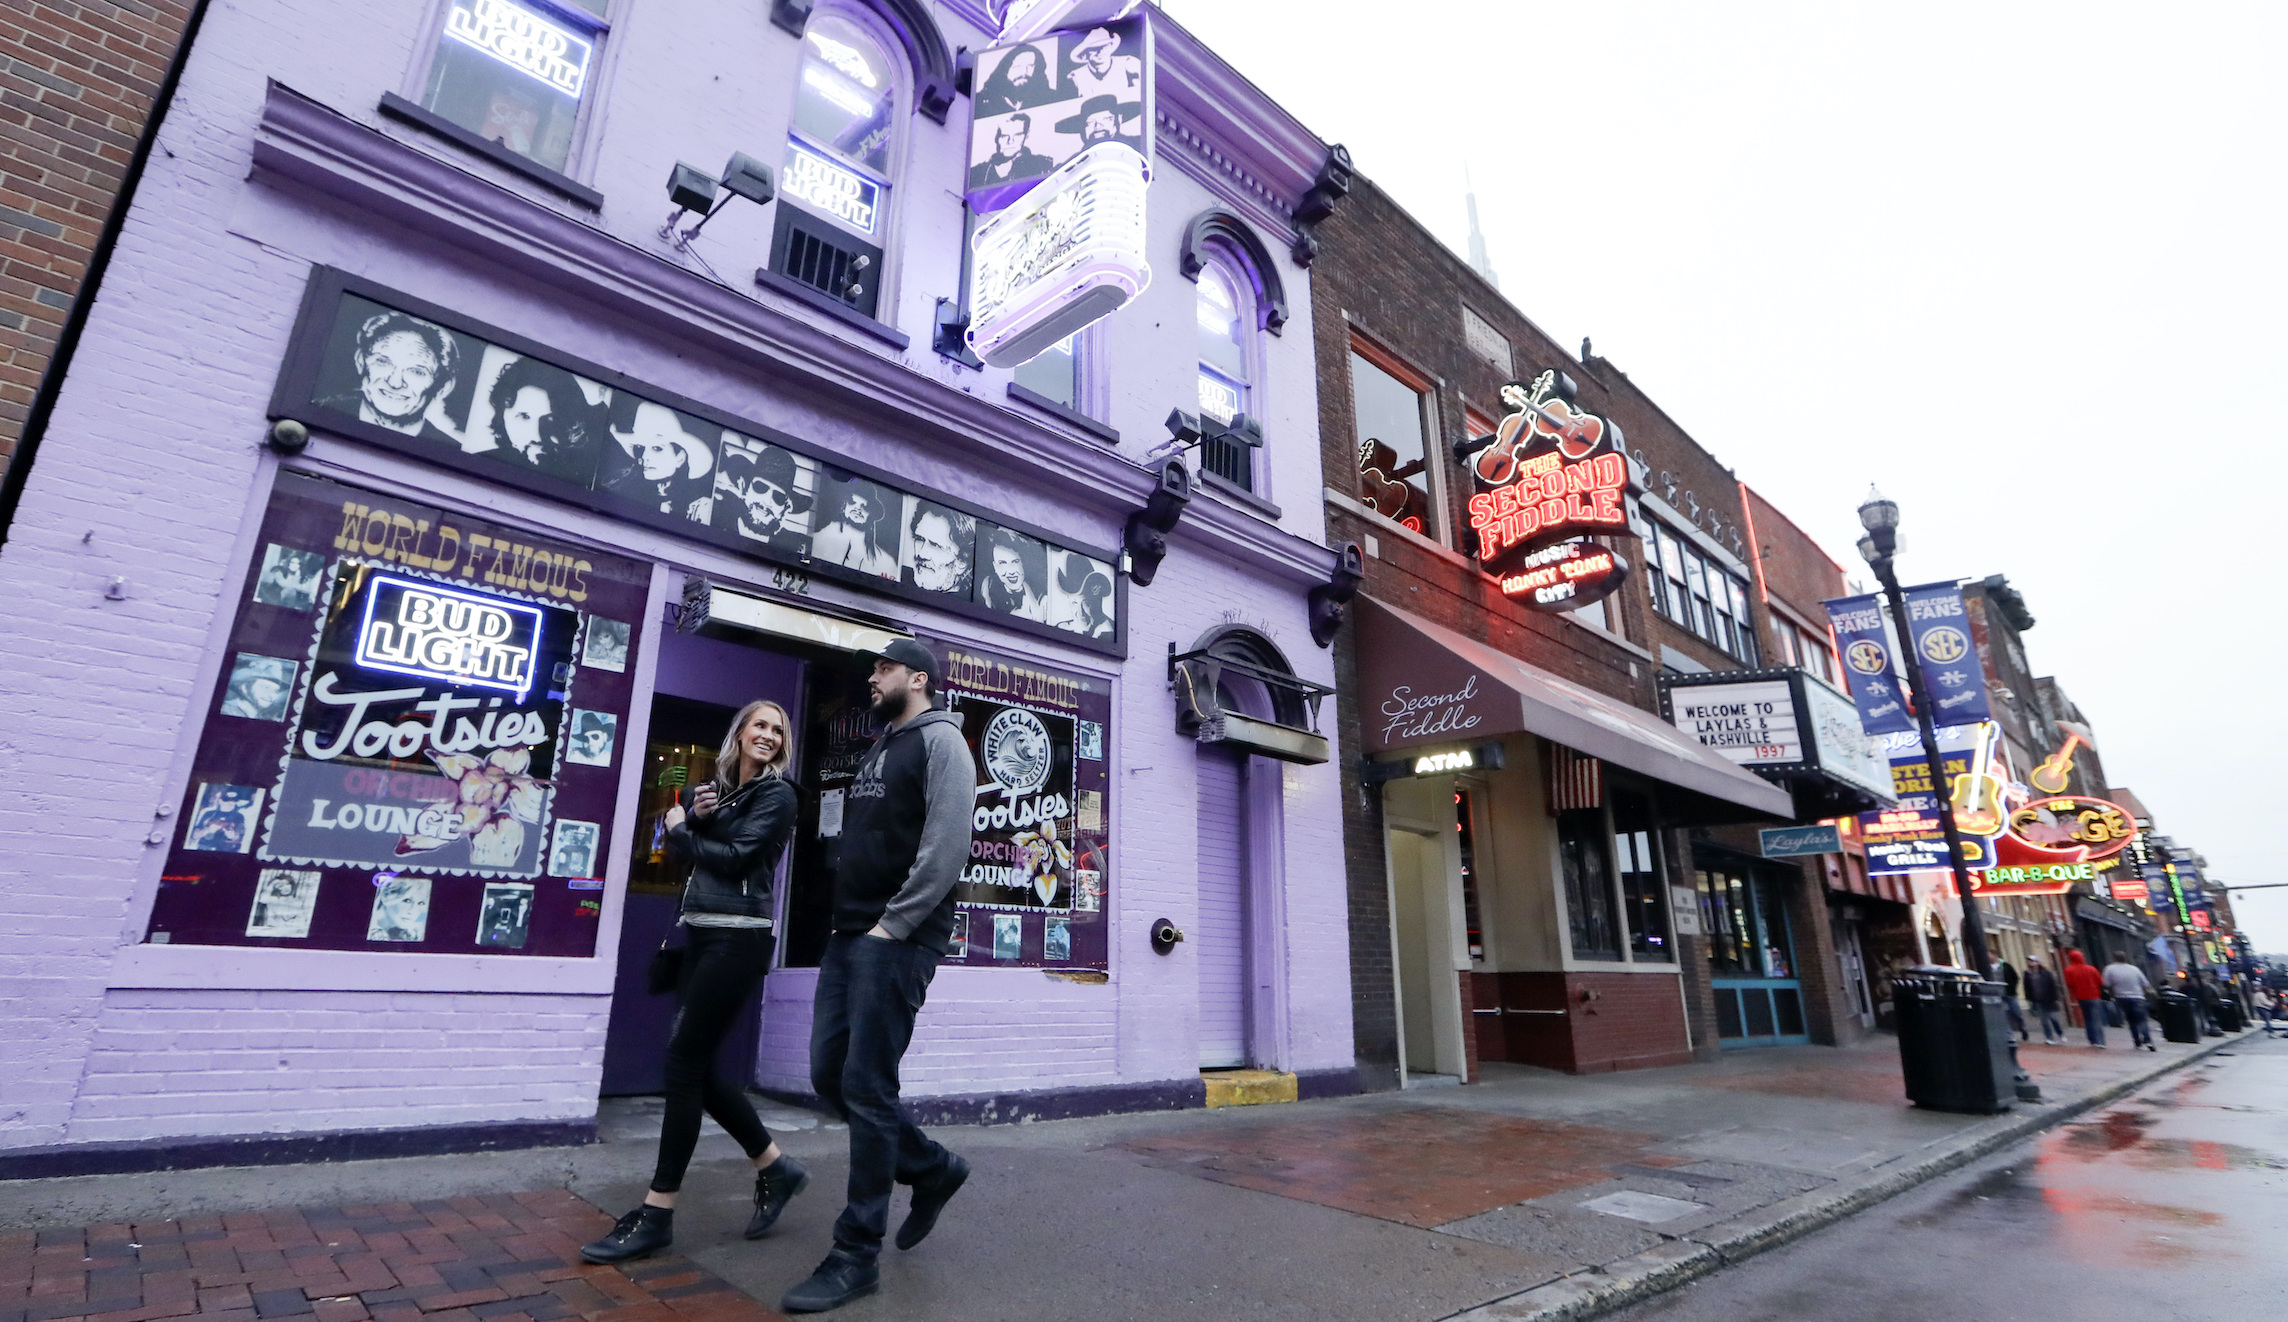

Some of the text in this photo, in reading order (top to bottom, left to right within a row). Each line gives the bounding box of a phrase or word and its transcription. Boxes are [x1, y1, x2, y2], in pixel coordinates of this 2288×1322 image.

[795, 152, 862, 201] BUD
[1518, 451, 1563, 480] THE
[1468, 452, 1627, 529] SECOND
[1477, 488, 1625, 562] FIDDLE
[334, 501, 593, 602] WORLD FAMOUS
[1524, 542, 1580, 569] MUSIC
[772, 568, 809, 594] 422
[1501, 553, 1614, 595] HONKY TONK
[1535, 579, 1578, 604] CITY
[1910, 595, 1960, 608] WELCOME
[398, 590, 513, 642] BUD
[1831, 608, 1879, 622] WELCOME
[1835, 617, 1882, 634] FANS
[1911, 602, 1963, 621] FANS
[1851, 643, 1883, 673] SEC
[1925, 630, 1963, 661] SEC
[947, 651, 1080, 710] WORLD FAMOUS
[1381, 675, 1478, 717] Second
[1685, 702, 1773, 718] WELCOME TO
[302, 671, 549, 760] Tootsies
[1382, 704, 1482, 744] Fiddle
[1697, 718, 1768, 733] LAYLAS &
[988, 713, 1043, 763] WHITE CLAW
[1700, 732, 1772, 746] NASHVILLE
[1755, 745, 1786, 758] 1997
[1024, 747, 1045, 784] SELTZER
[1415, 751, 1474, 774] ATM
[344, 769, 460, 803] ORCHID
[1000, 769, 1022, 786] HARD
[307, 799, 464, 840] LOUNGE
[1766, 832, 1832, 851] Layla's
[1887, 853, 1938, 866] GRILL
[1985, 863, 2095, 884] BAR-B-QUE
[958, 862, 1034, 889] LOUNGE
